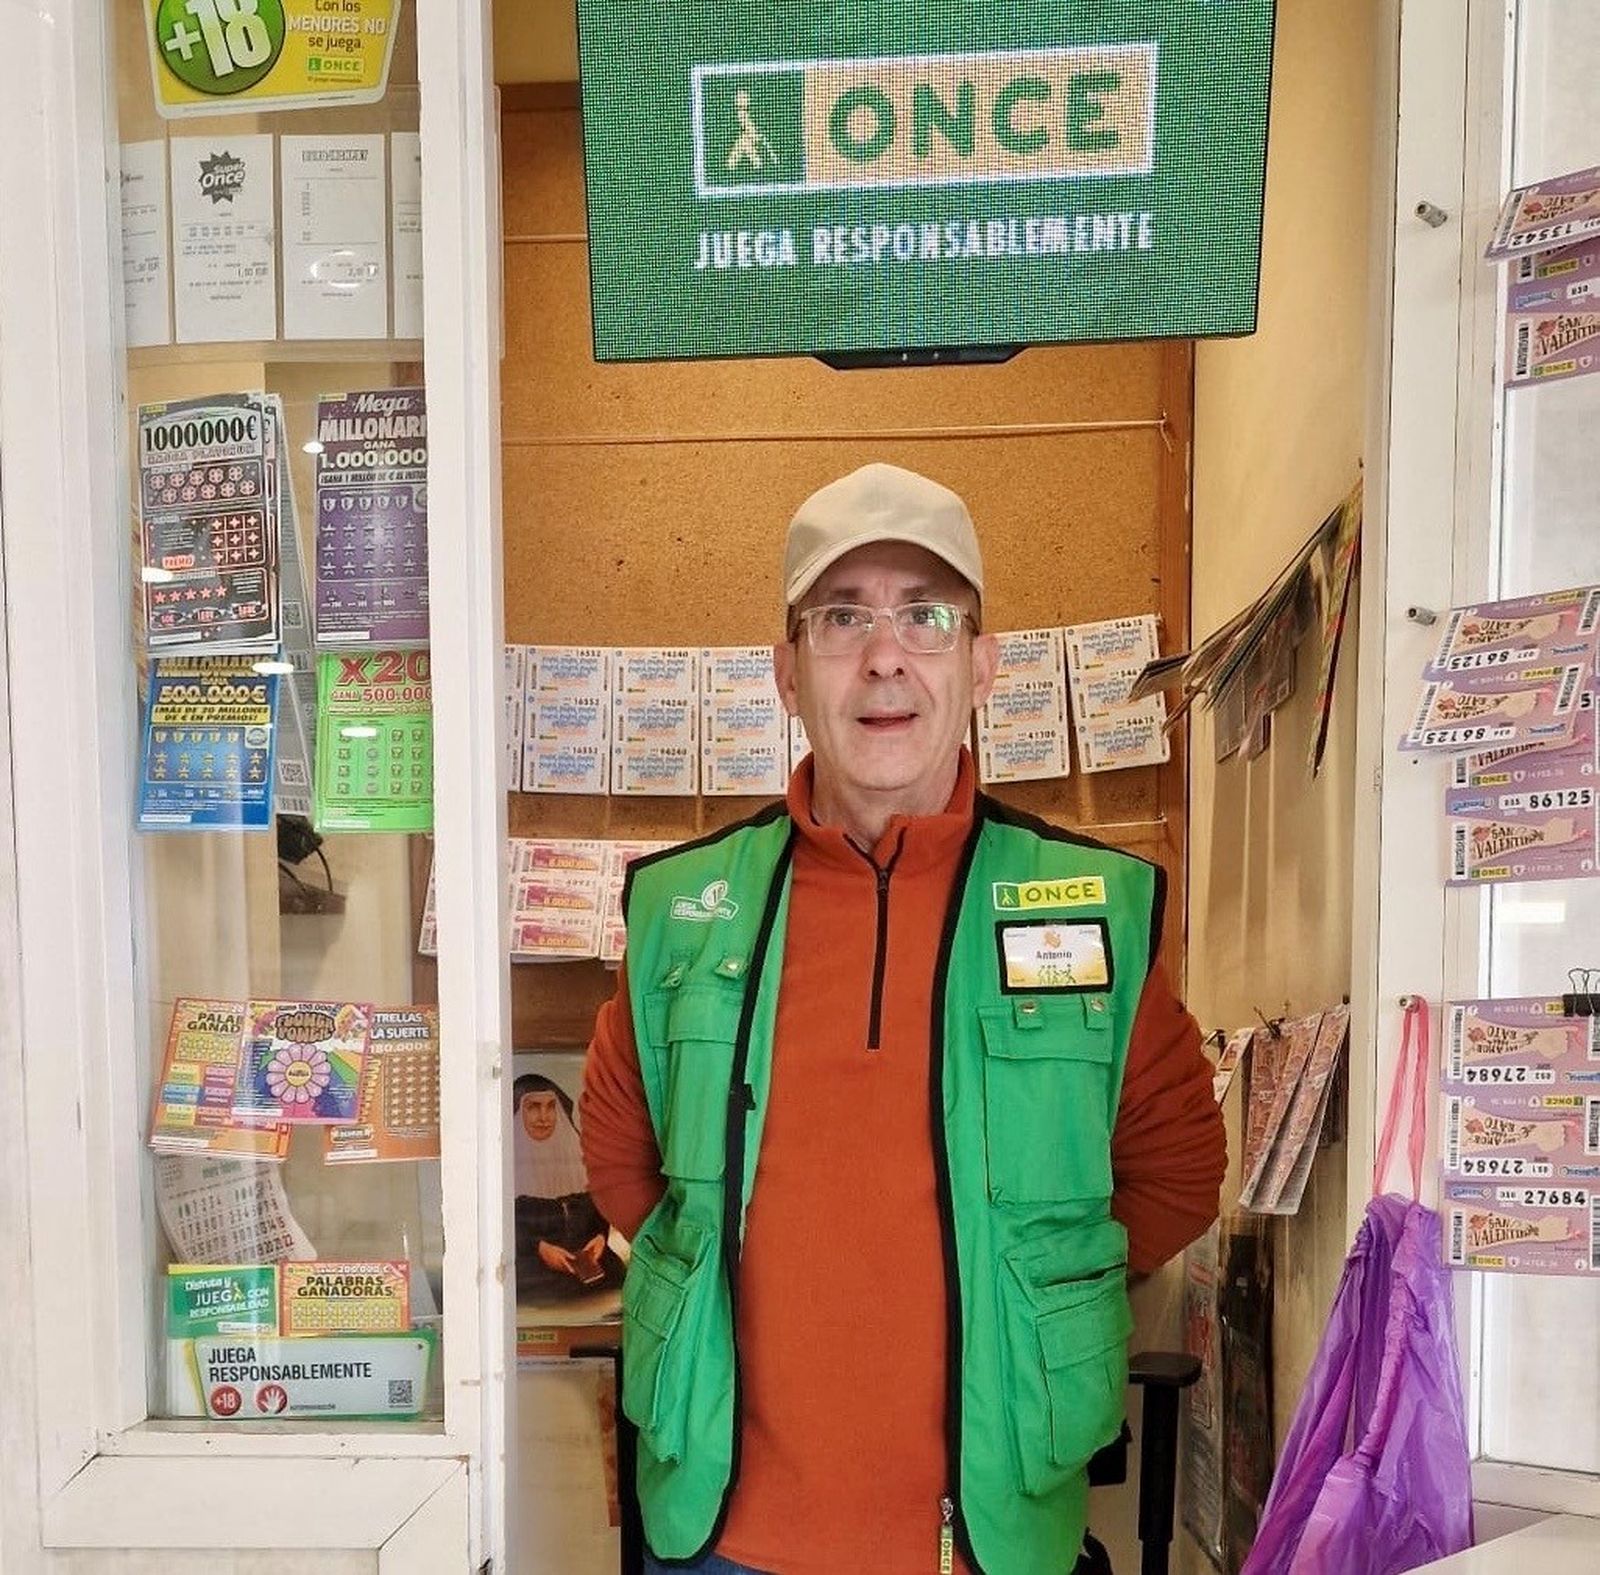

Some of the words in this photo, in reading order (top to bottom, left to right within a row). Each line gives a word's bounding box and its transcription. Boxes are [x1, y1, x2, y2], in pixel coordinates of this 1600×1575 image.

[289, 17, 360, 33] MENORES
[364, 18, 386, 34] NO
[165, 0, 272, 78] +18
[308, 36, 323, 47] se
[323, 58, 361, 71] ONCE
[828, 70, 1121, 162] ONCE
[202, 170, 244, 188] Once
[695, 230, 798, 269] JUEGA
[814, 212, 1154, 265] RESPONSABLEMENTE
[1545, 361, 1574, 373] ONCE
[353, 394, 410, 416] Mega
[144, 415, 258, 452] 1000000€
[363, 440, 396, 450] GANA
[1450, 651, 1510, 669] 86125
[158, 685, 267, 704] 500.000€
[1425, 727, 1486, 744] 86125
[1529, 790, 1591, 808] 86125
[1025, 882, 1096, 902] ONCE
[1035, 950, 1072, 960] Antonio
[373, 1012, 423, 1024] TRELLAS
[370, 1026, 386, 1039] LA
[386, 1026, 430, 1039] SUERTE
[1467, 1067, 1526, 1083] 27684
[1545, 1098, 1572, 1106] ONCE
[1463, 1160, 1524, 1174] 27684
[1524, 1190, 1586, 1205] 27684
[184, 1278, 223, 1292] Disfruta
[306, 1275, 384, 1286] PALABRAS
[297, 1286, 393, 1297] GANADORAS
[208, 1346, 257, 1365] JUEGA
[209, 1362, 372, 1383] RESPONSABLEMENTE
[213, 1392, 236, 1410] +18
[943, 1540, 952, 1571] ONCE
